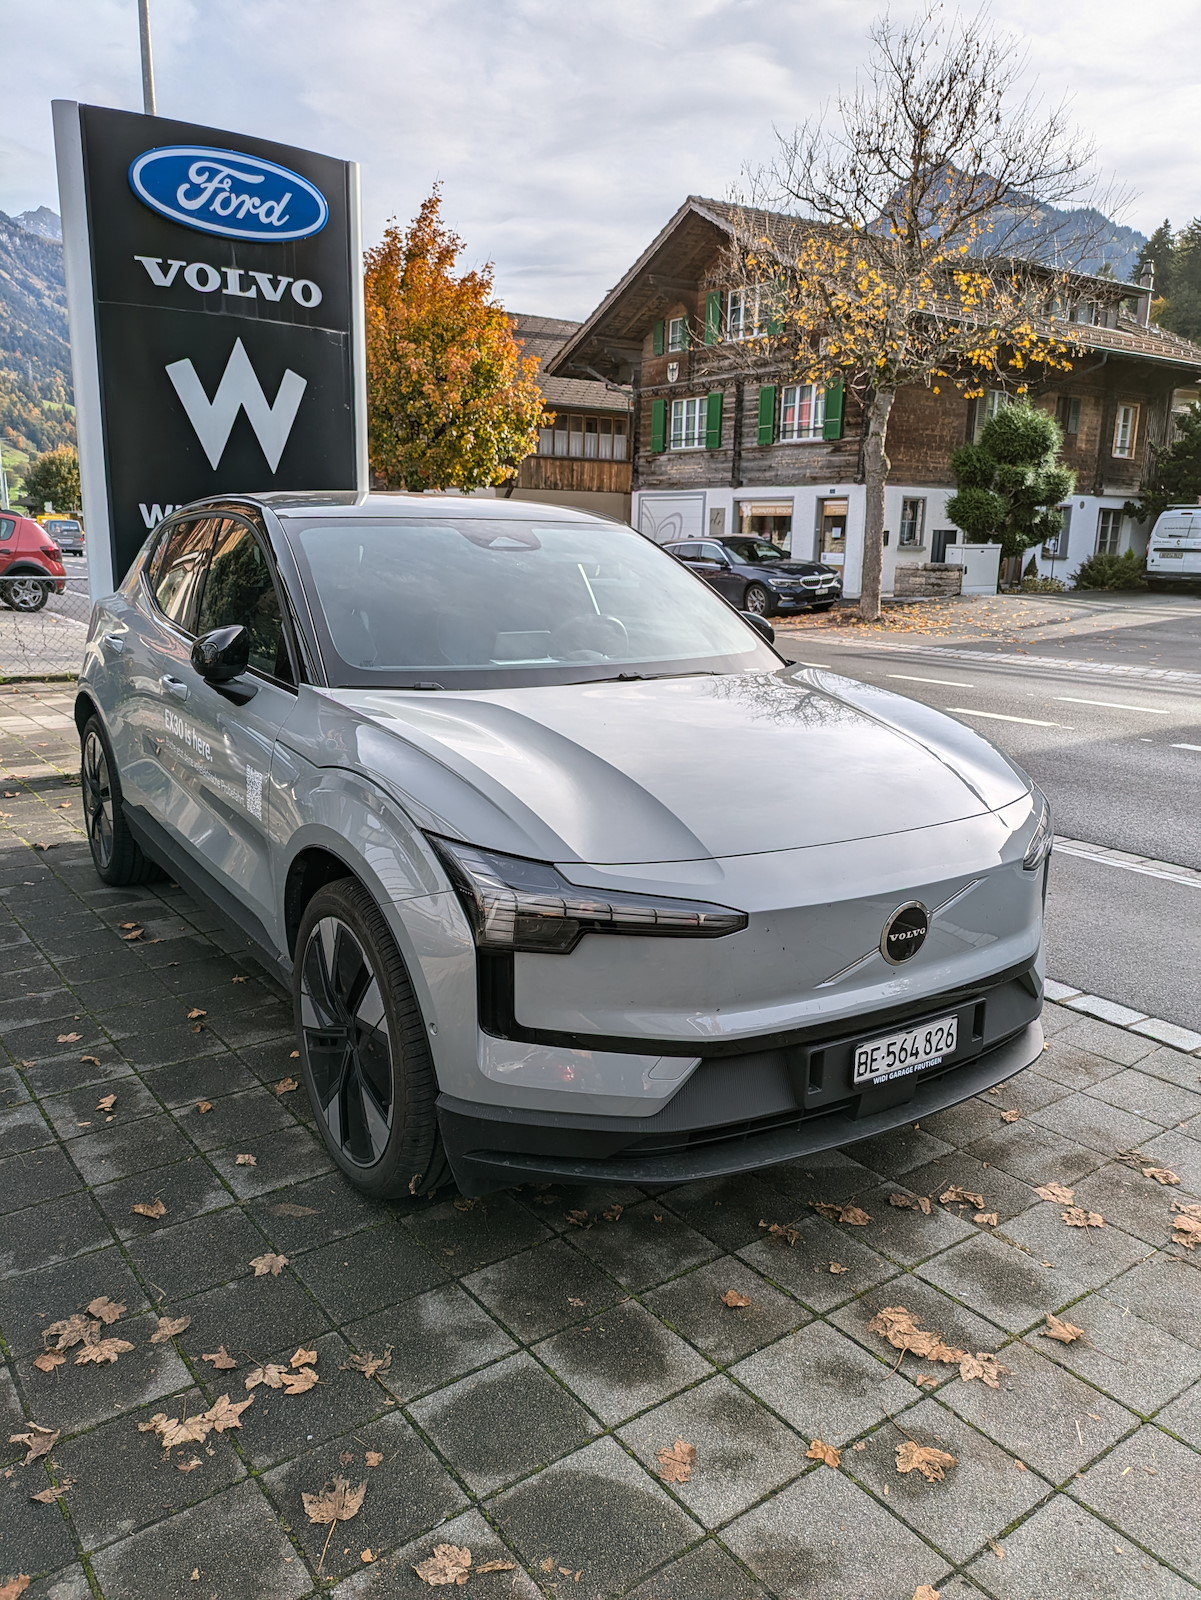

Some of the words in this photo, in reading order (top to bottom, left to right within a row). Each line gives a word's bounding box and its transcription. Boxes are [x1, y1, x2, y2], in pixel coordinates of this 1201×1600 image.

[177, 161, 292, 227] Ford
[134, 255, 323, 309] VOLVO
[165, 336, 307, 475] W
[164, 708, 183, 740] EX30
[184, 724, 192, 746] is
[192, 728, 213, 762] here.
[889, 927, 926, 942] VOLVO
[873, 1074, 888, 1085] WIDI
[889, 1066, 914, 1080] GARAGE
[914, 1056, 942, 1072] FRUTIGEN
